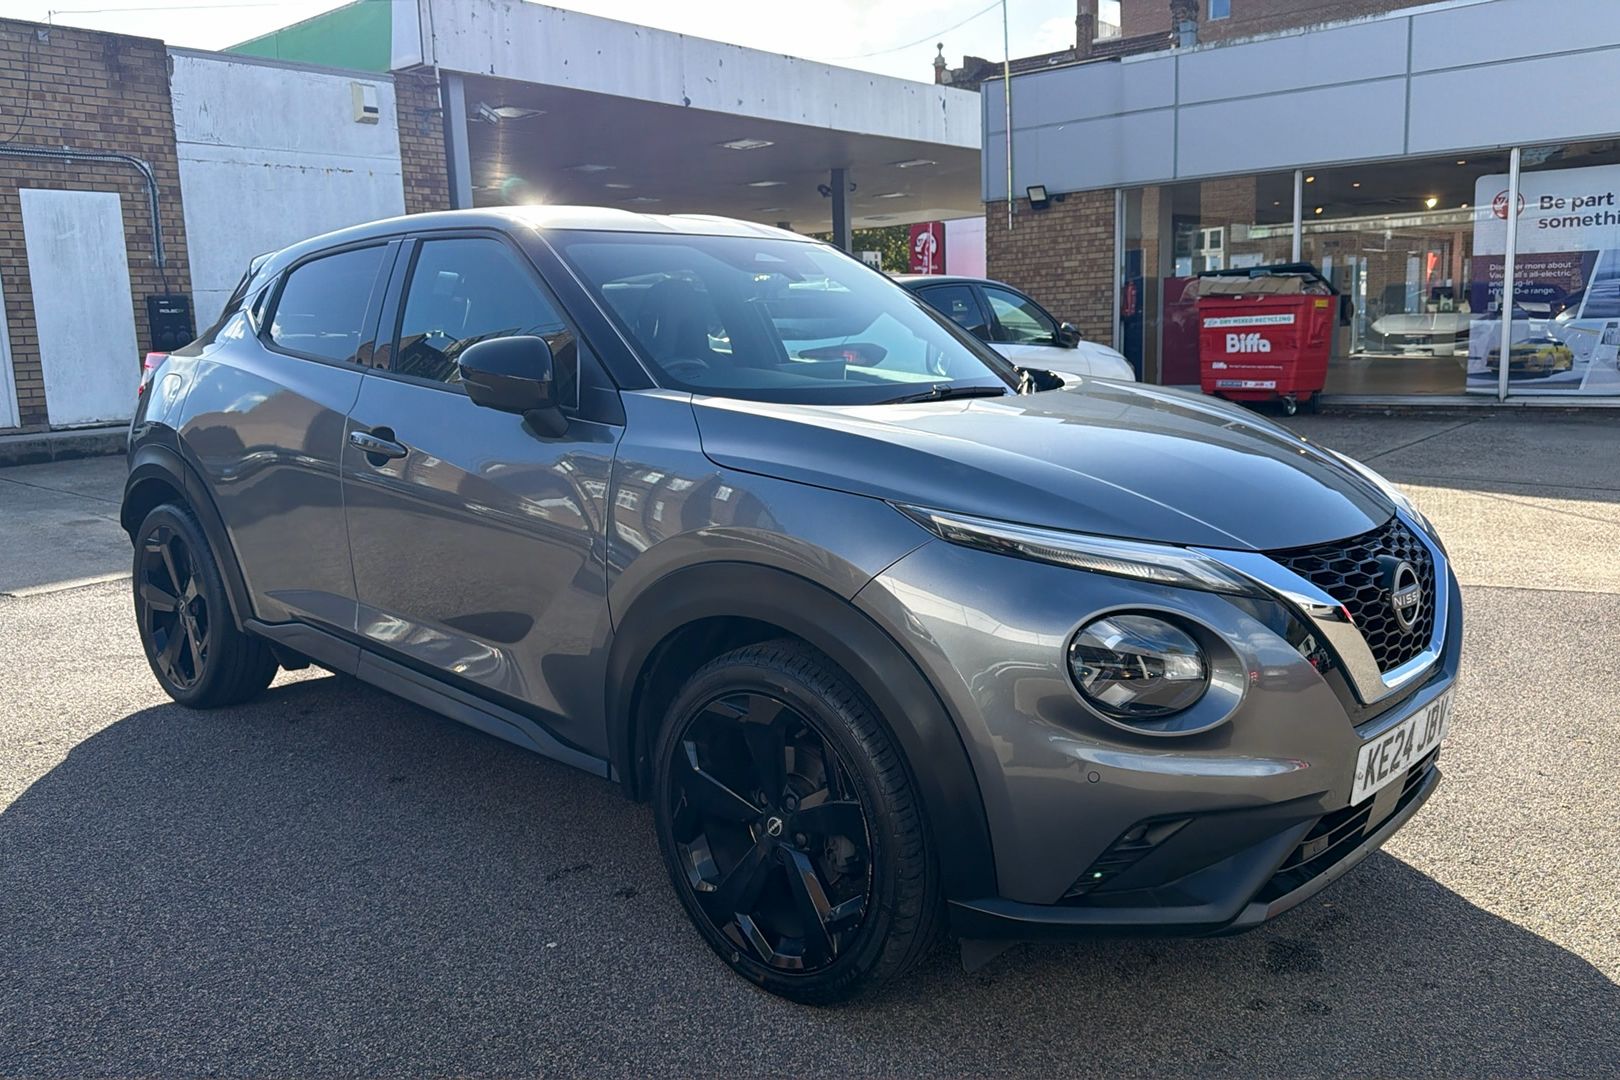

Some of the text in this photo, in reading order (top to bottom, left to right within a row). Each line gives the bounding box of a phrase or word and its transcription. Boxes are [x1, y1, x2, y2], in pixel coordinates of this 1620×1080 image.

[1540, 192, 1614, 212] Be part
[1529, 270, 1571, 278] all-electric
[1226, 333, 1271, 353] Biffa
[1394, 591, 1418, 606] NISS
[1362, 696, 1449, 791] KE24 JBV
